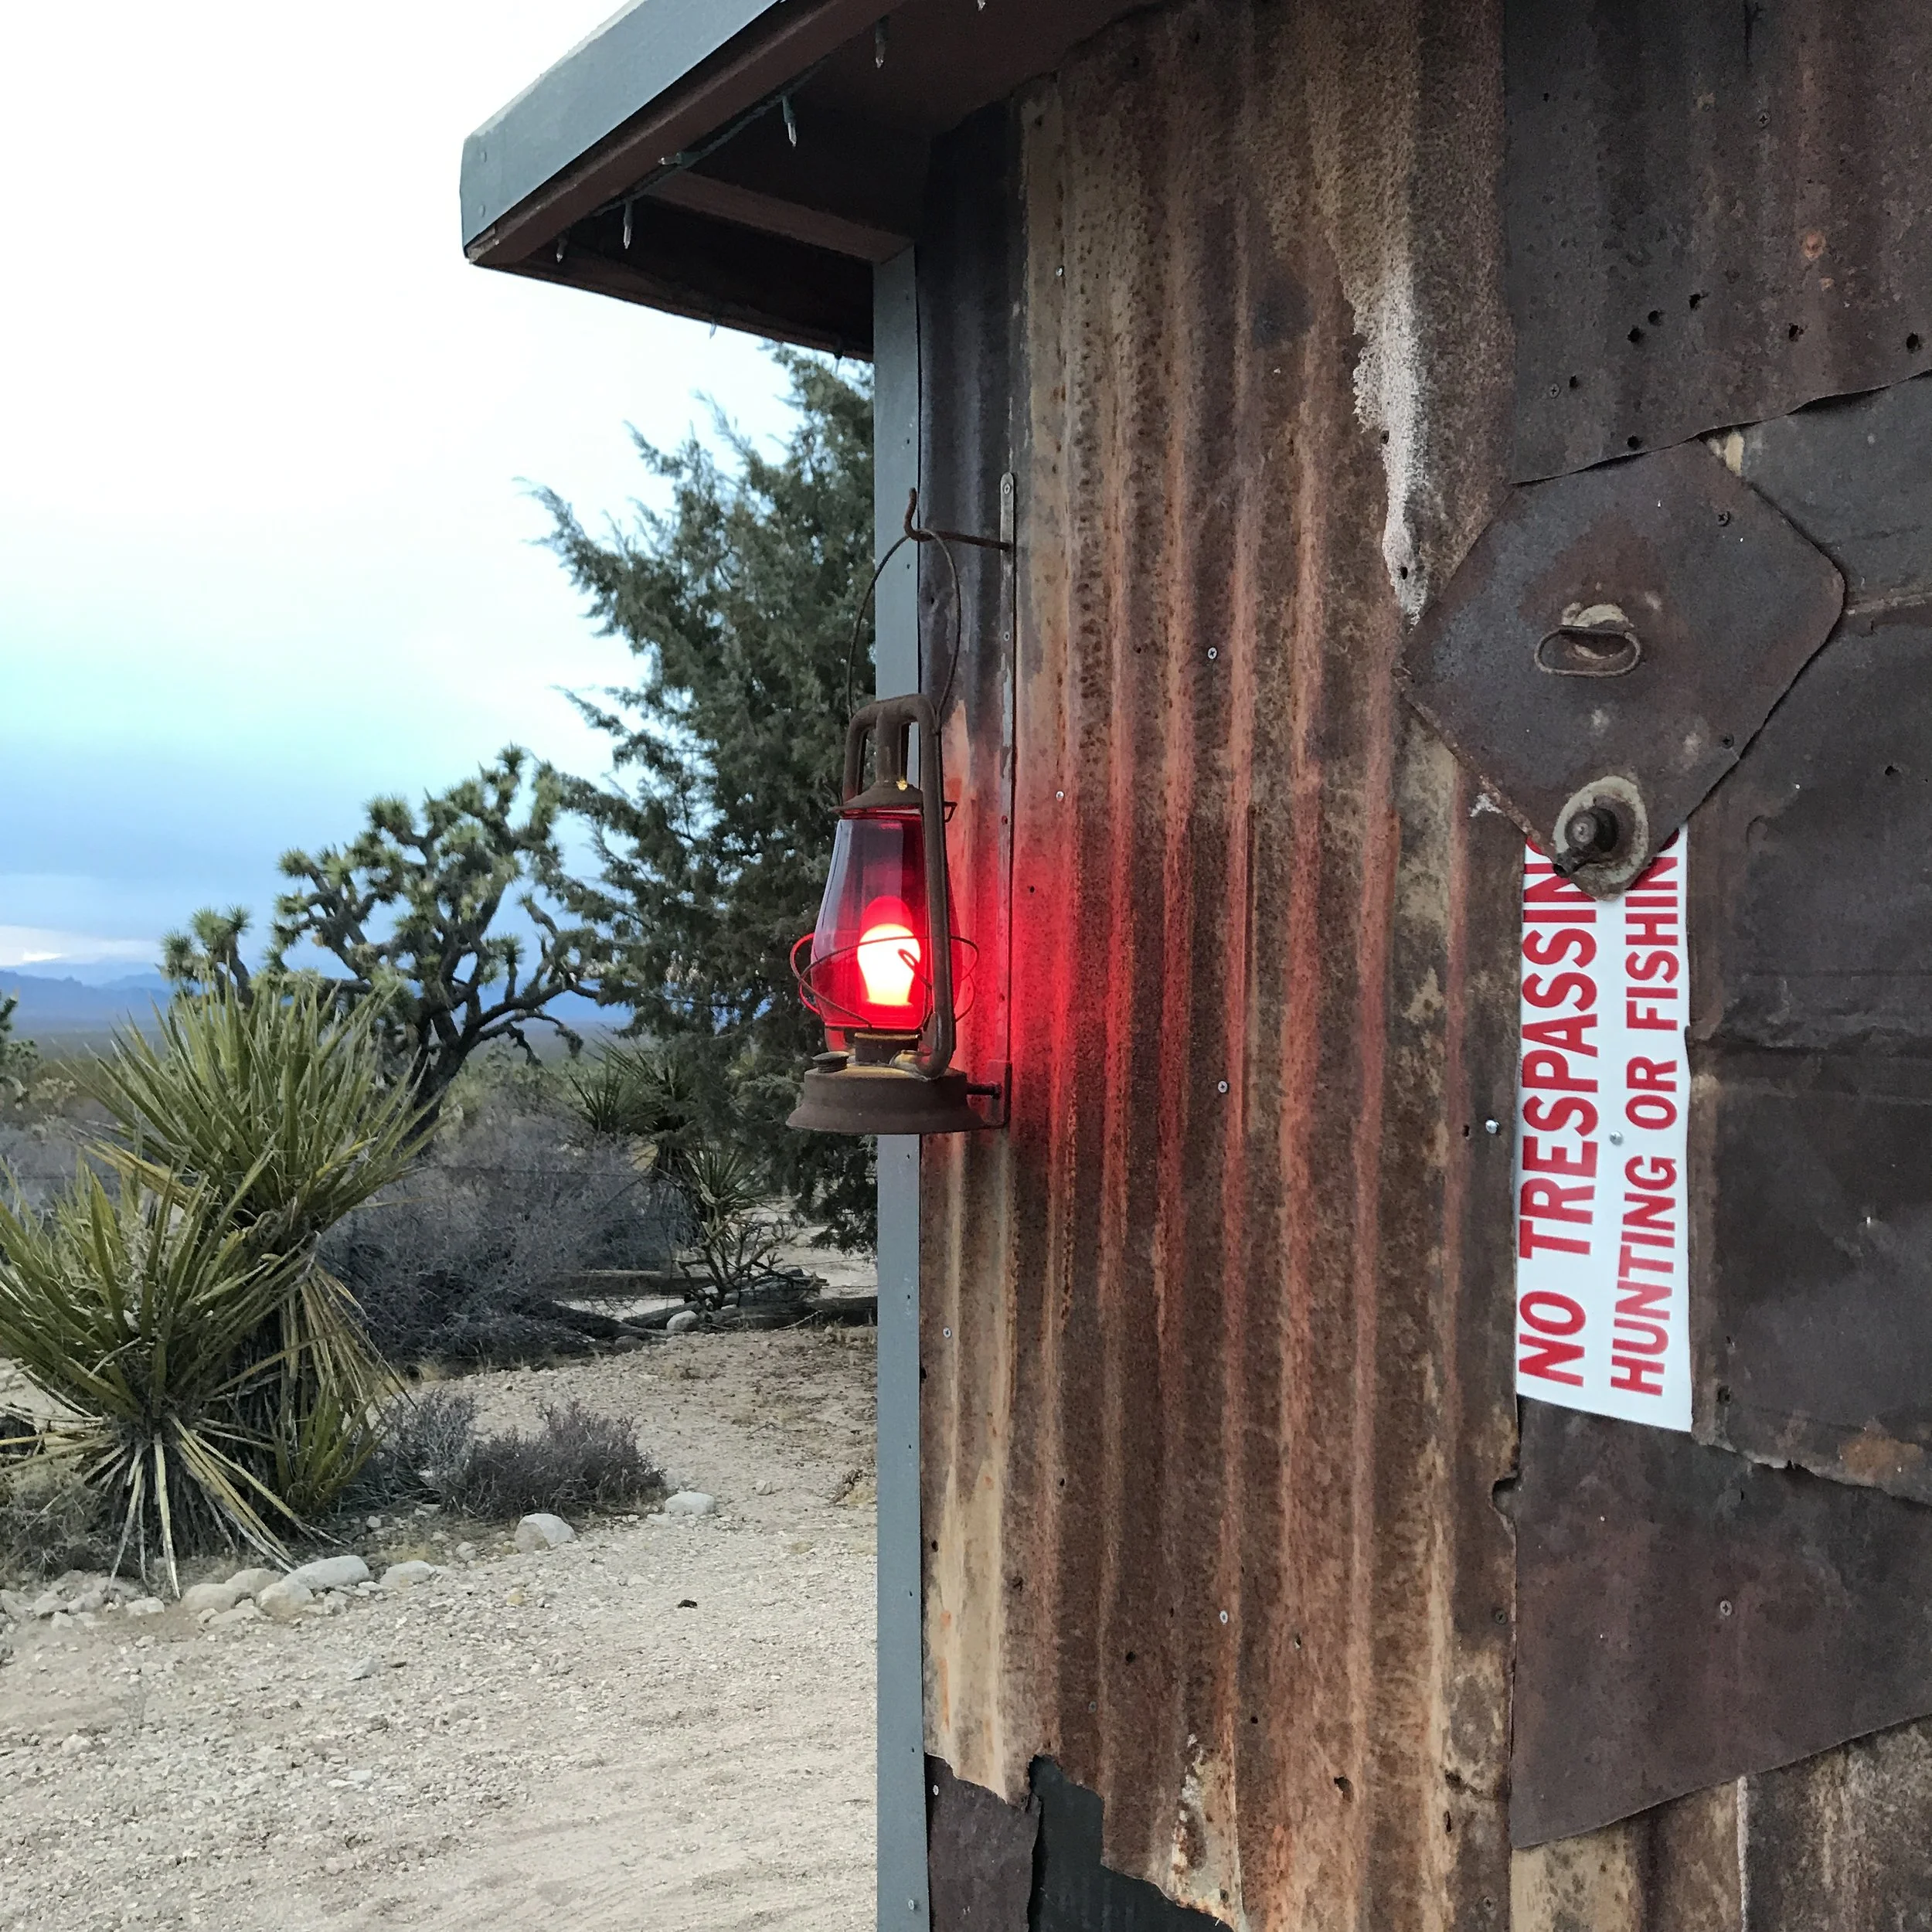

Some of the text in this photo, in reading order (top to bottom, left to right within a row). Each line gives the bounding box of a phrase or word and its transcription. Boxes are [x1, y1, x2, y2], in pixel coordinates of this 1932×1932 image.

[1519, 837, 1598, 1387] NO TRESPASSIN
[1611, 828, 1679, 1396] HUNTING OR FISHIN
